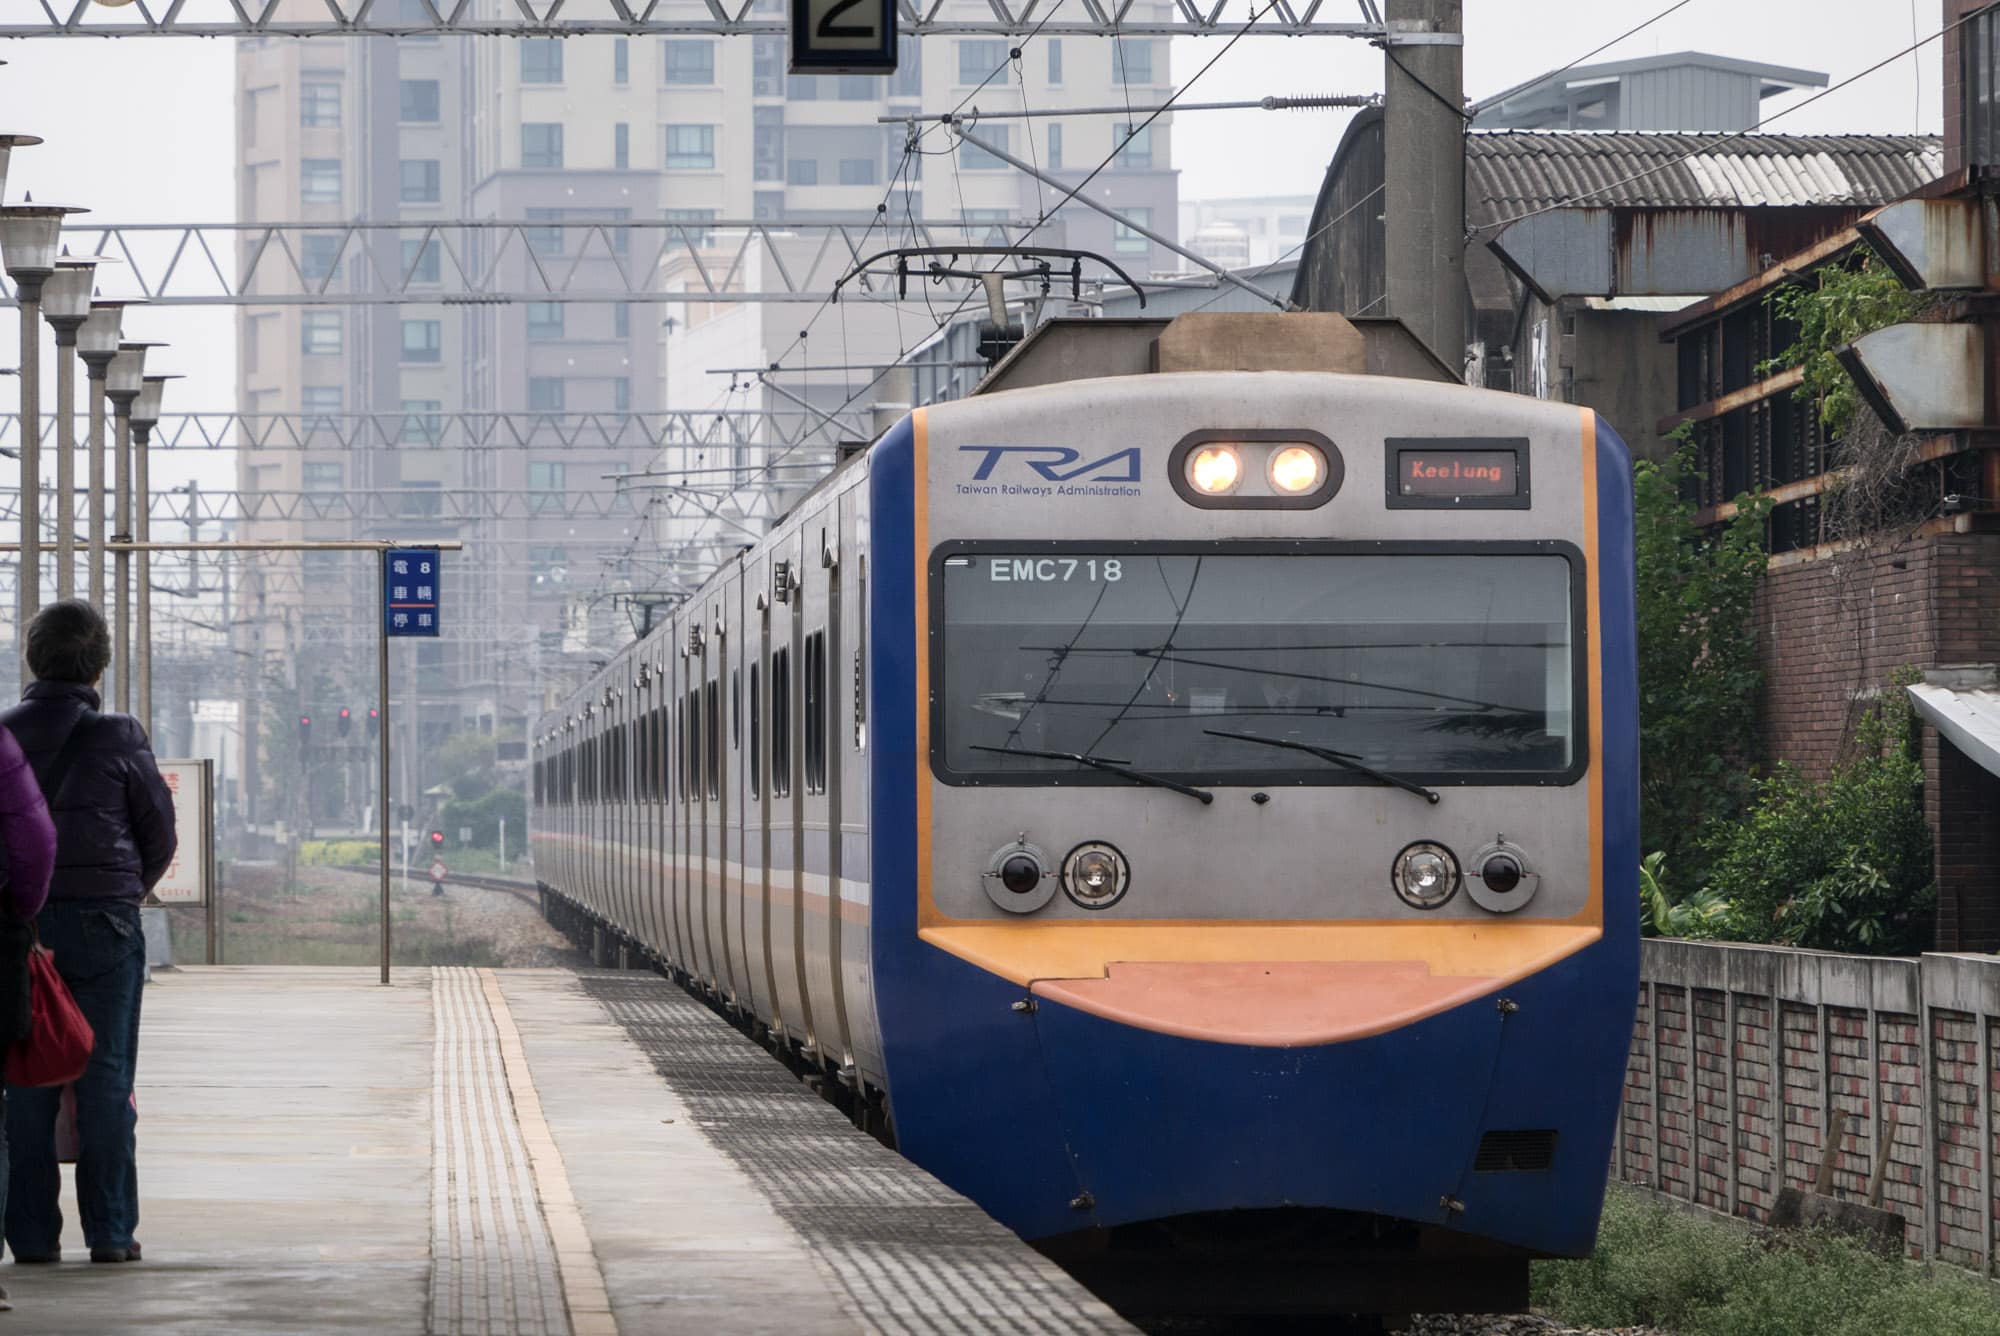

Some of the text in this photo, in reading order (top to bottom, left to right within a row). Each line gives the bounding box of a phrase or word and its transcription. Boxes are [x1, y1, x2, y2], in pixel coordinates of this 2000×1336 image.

[958, 445, 1141, 482] TRA
[1411, 460, 1502, 481] Keelung
[956, 483, 1141, 497] Taiwan Railways Administration
[990, 559, 1122, 582] EMC718
